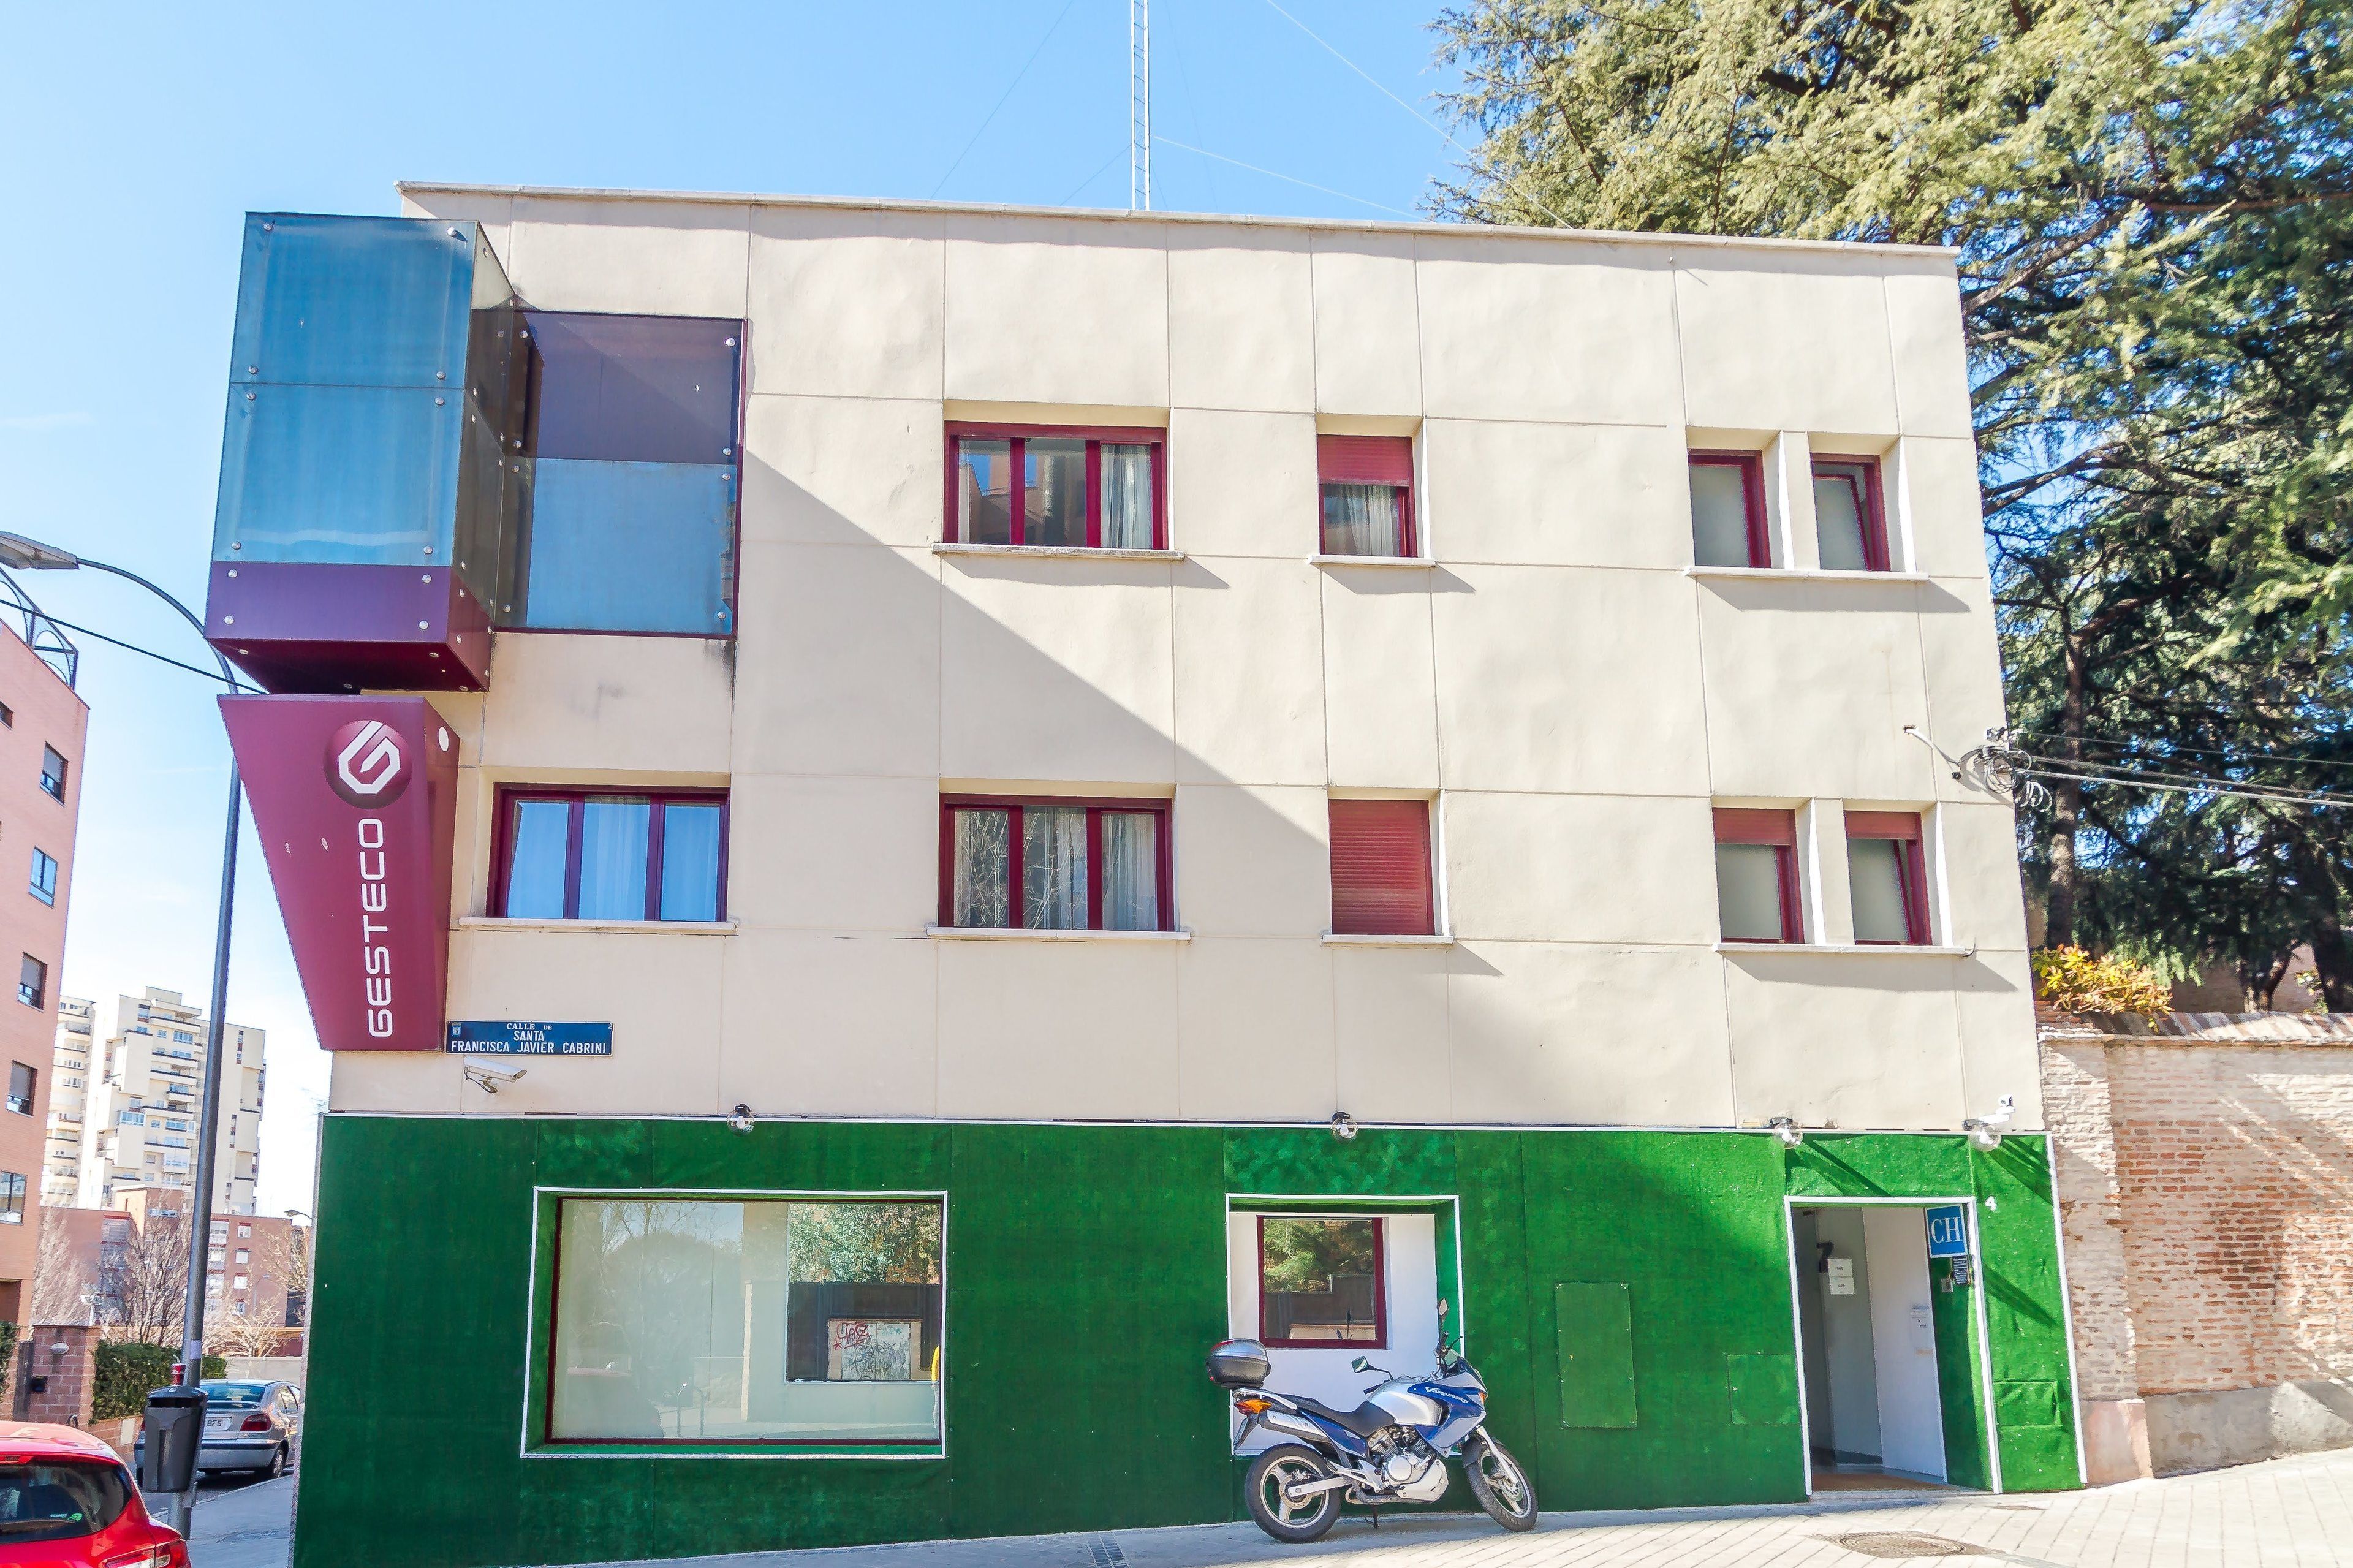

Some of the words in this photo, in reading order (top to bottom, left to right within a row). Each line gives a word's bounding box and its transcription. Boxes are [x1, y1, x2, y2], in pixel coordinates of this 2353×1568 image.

[358, 817, 393, 1038] GESTECO
[513, 1031, 545, 1042] SANTA
[451, 1040, 510, 1053] FRANCISCA
[517, 1042, 555, 1053] JAVIER
[562, 1042, 606, 1054] CABRINI
[1985, 1196, 1998, 1211] 4
[1931, 1216, 1962, 1244] CH
